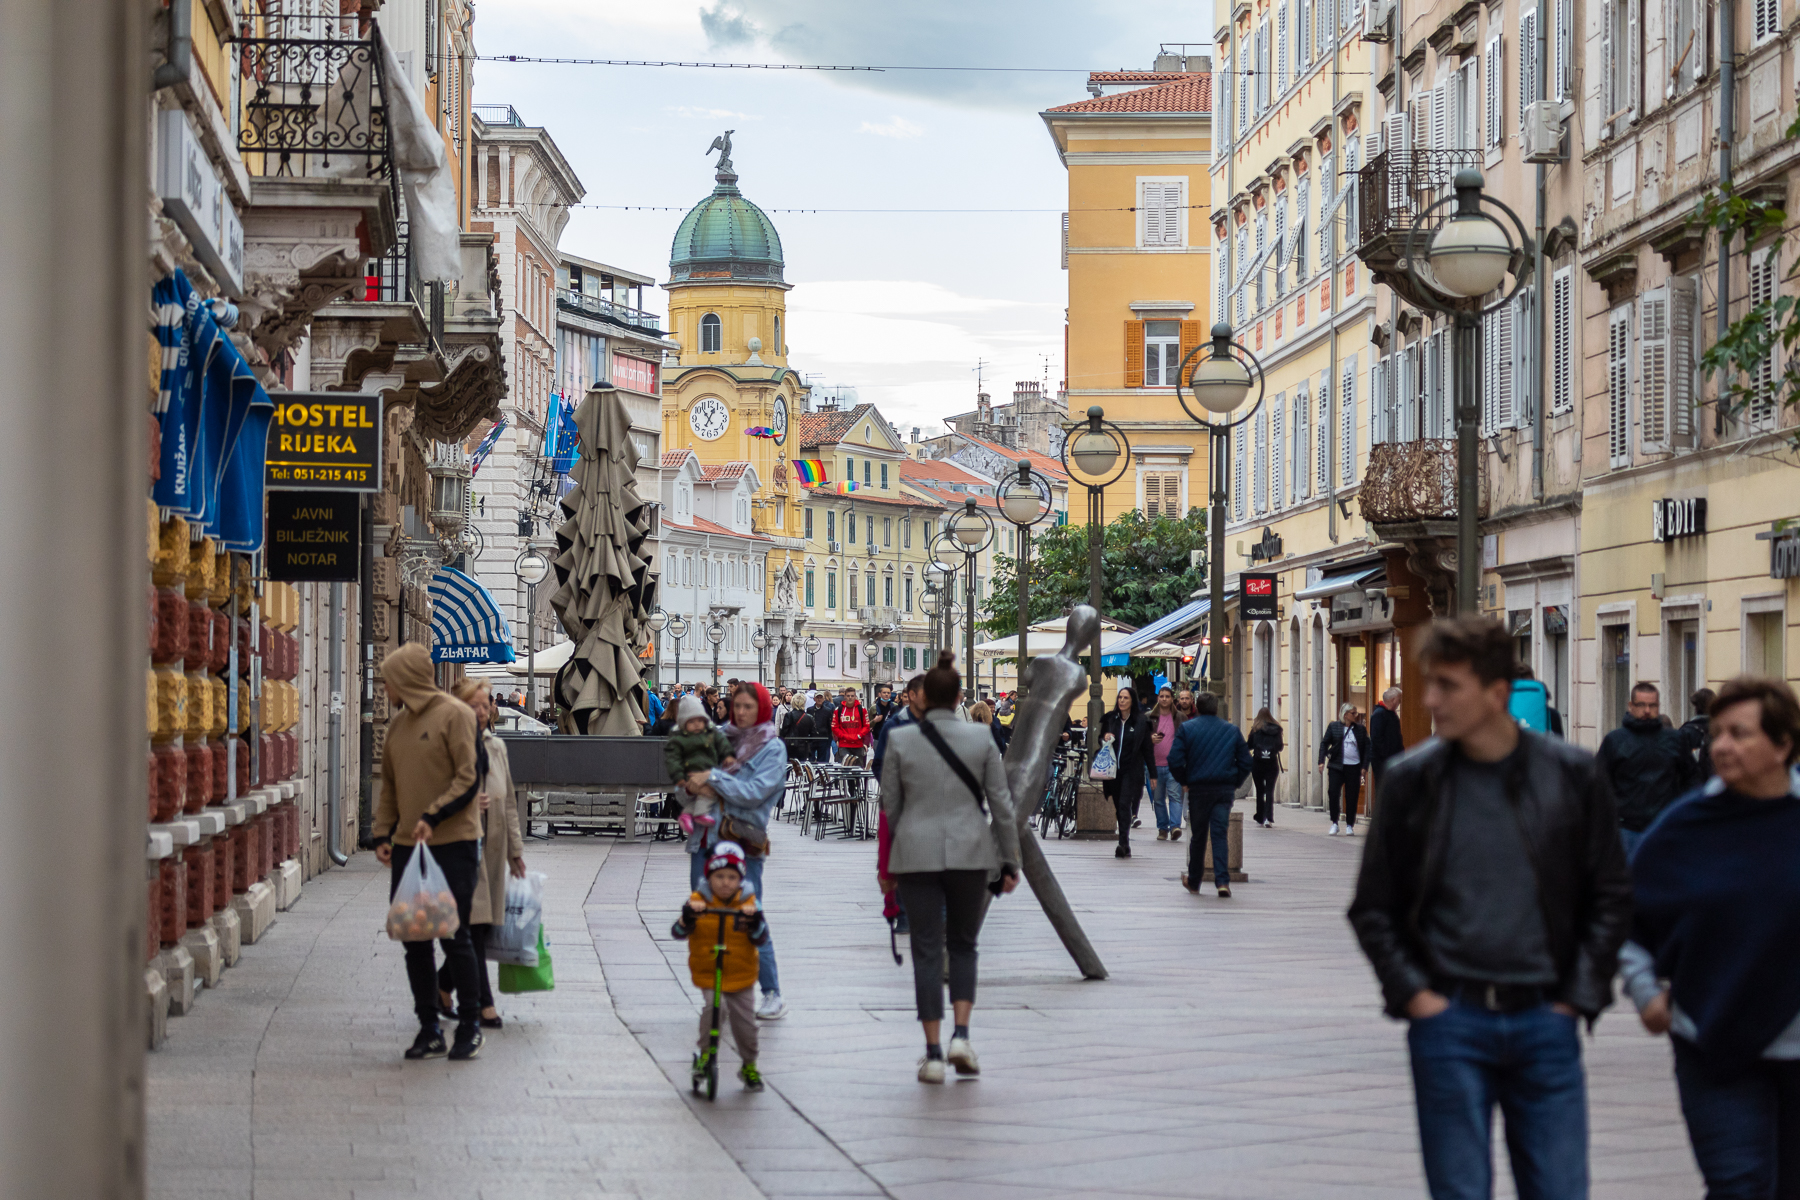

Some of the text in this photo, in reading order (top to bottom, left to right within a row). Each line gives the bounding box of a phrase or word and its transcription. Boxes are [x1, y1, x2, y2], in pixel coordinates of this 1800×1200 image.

[280, 433, 357, 453] RIJEKA
[174, 423, 187, 495] KNJIŽARA
[270, 468, 366, 482] Tel: 051-215 415
[292, 508, 333, 520] JAVNI
[1667, 499, 1697, 536] EDIT
[276, 527, 349, 543] BILJEŽNIK
[287, 553, 337, 565] NOTAR
[439, 646, 490, 659] ZLATAR
